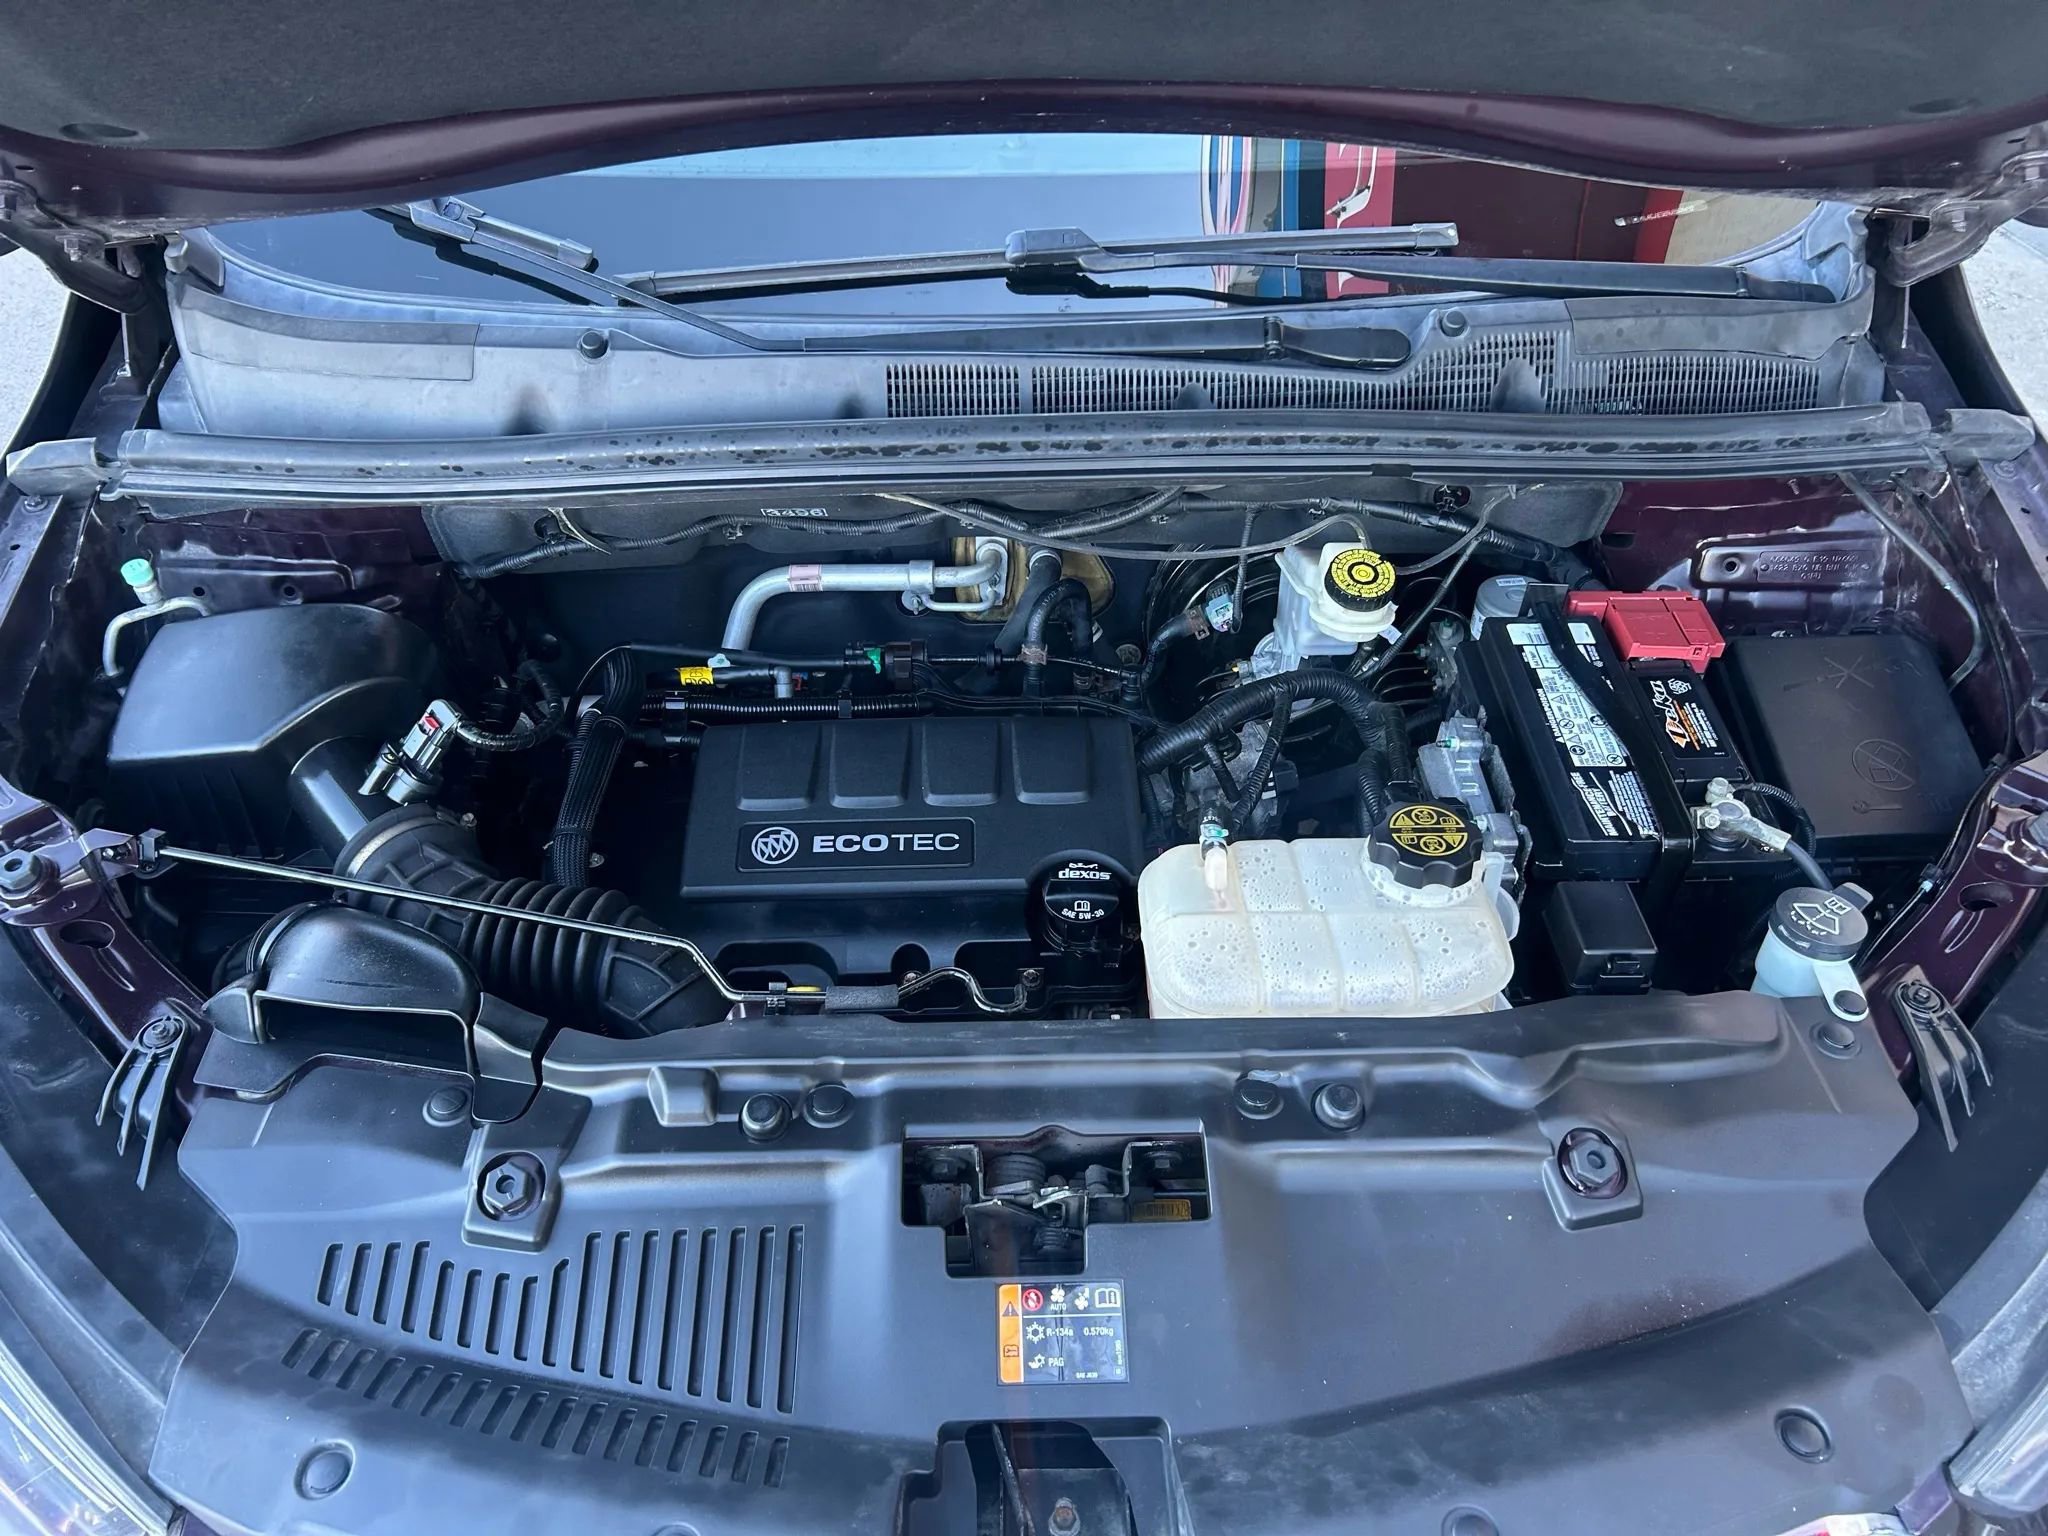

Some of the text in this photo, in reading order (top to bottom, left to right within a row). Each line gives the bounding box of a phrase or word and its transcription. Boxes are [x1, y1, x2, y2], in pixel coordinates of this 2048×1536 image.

[812, 833, 960, 853] ECOTEC
[1058, 868, 1112, 880] dexos
[1061, 908, 1105, 920] SAE 5W-30
[1050, 1303, 1067, 1311] AUTO
[1046, 1327, 1114, 1337] R-134a 0.570kg
[1048, 1357, 1065, 1367] PAG
